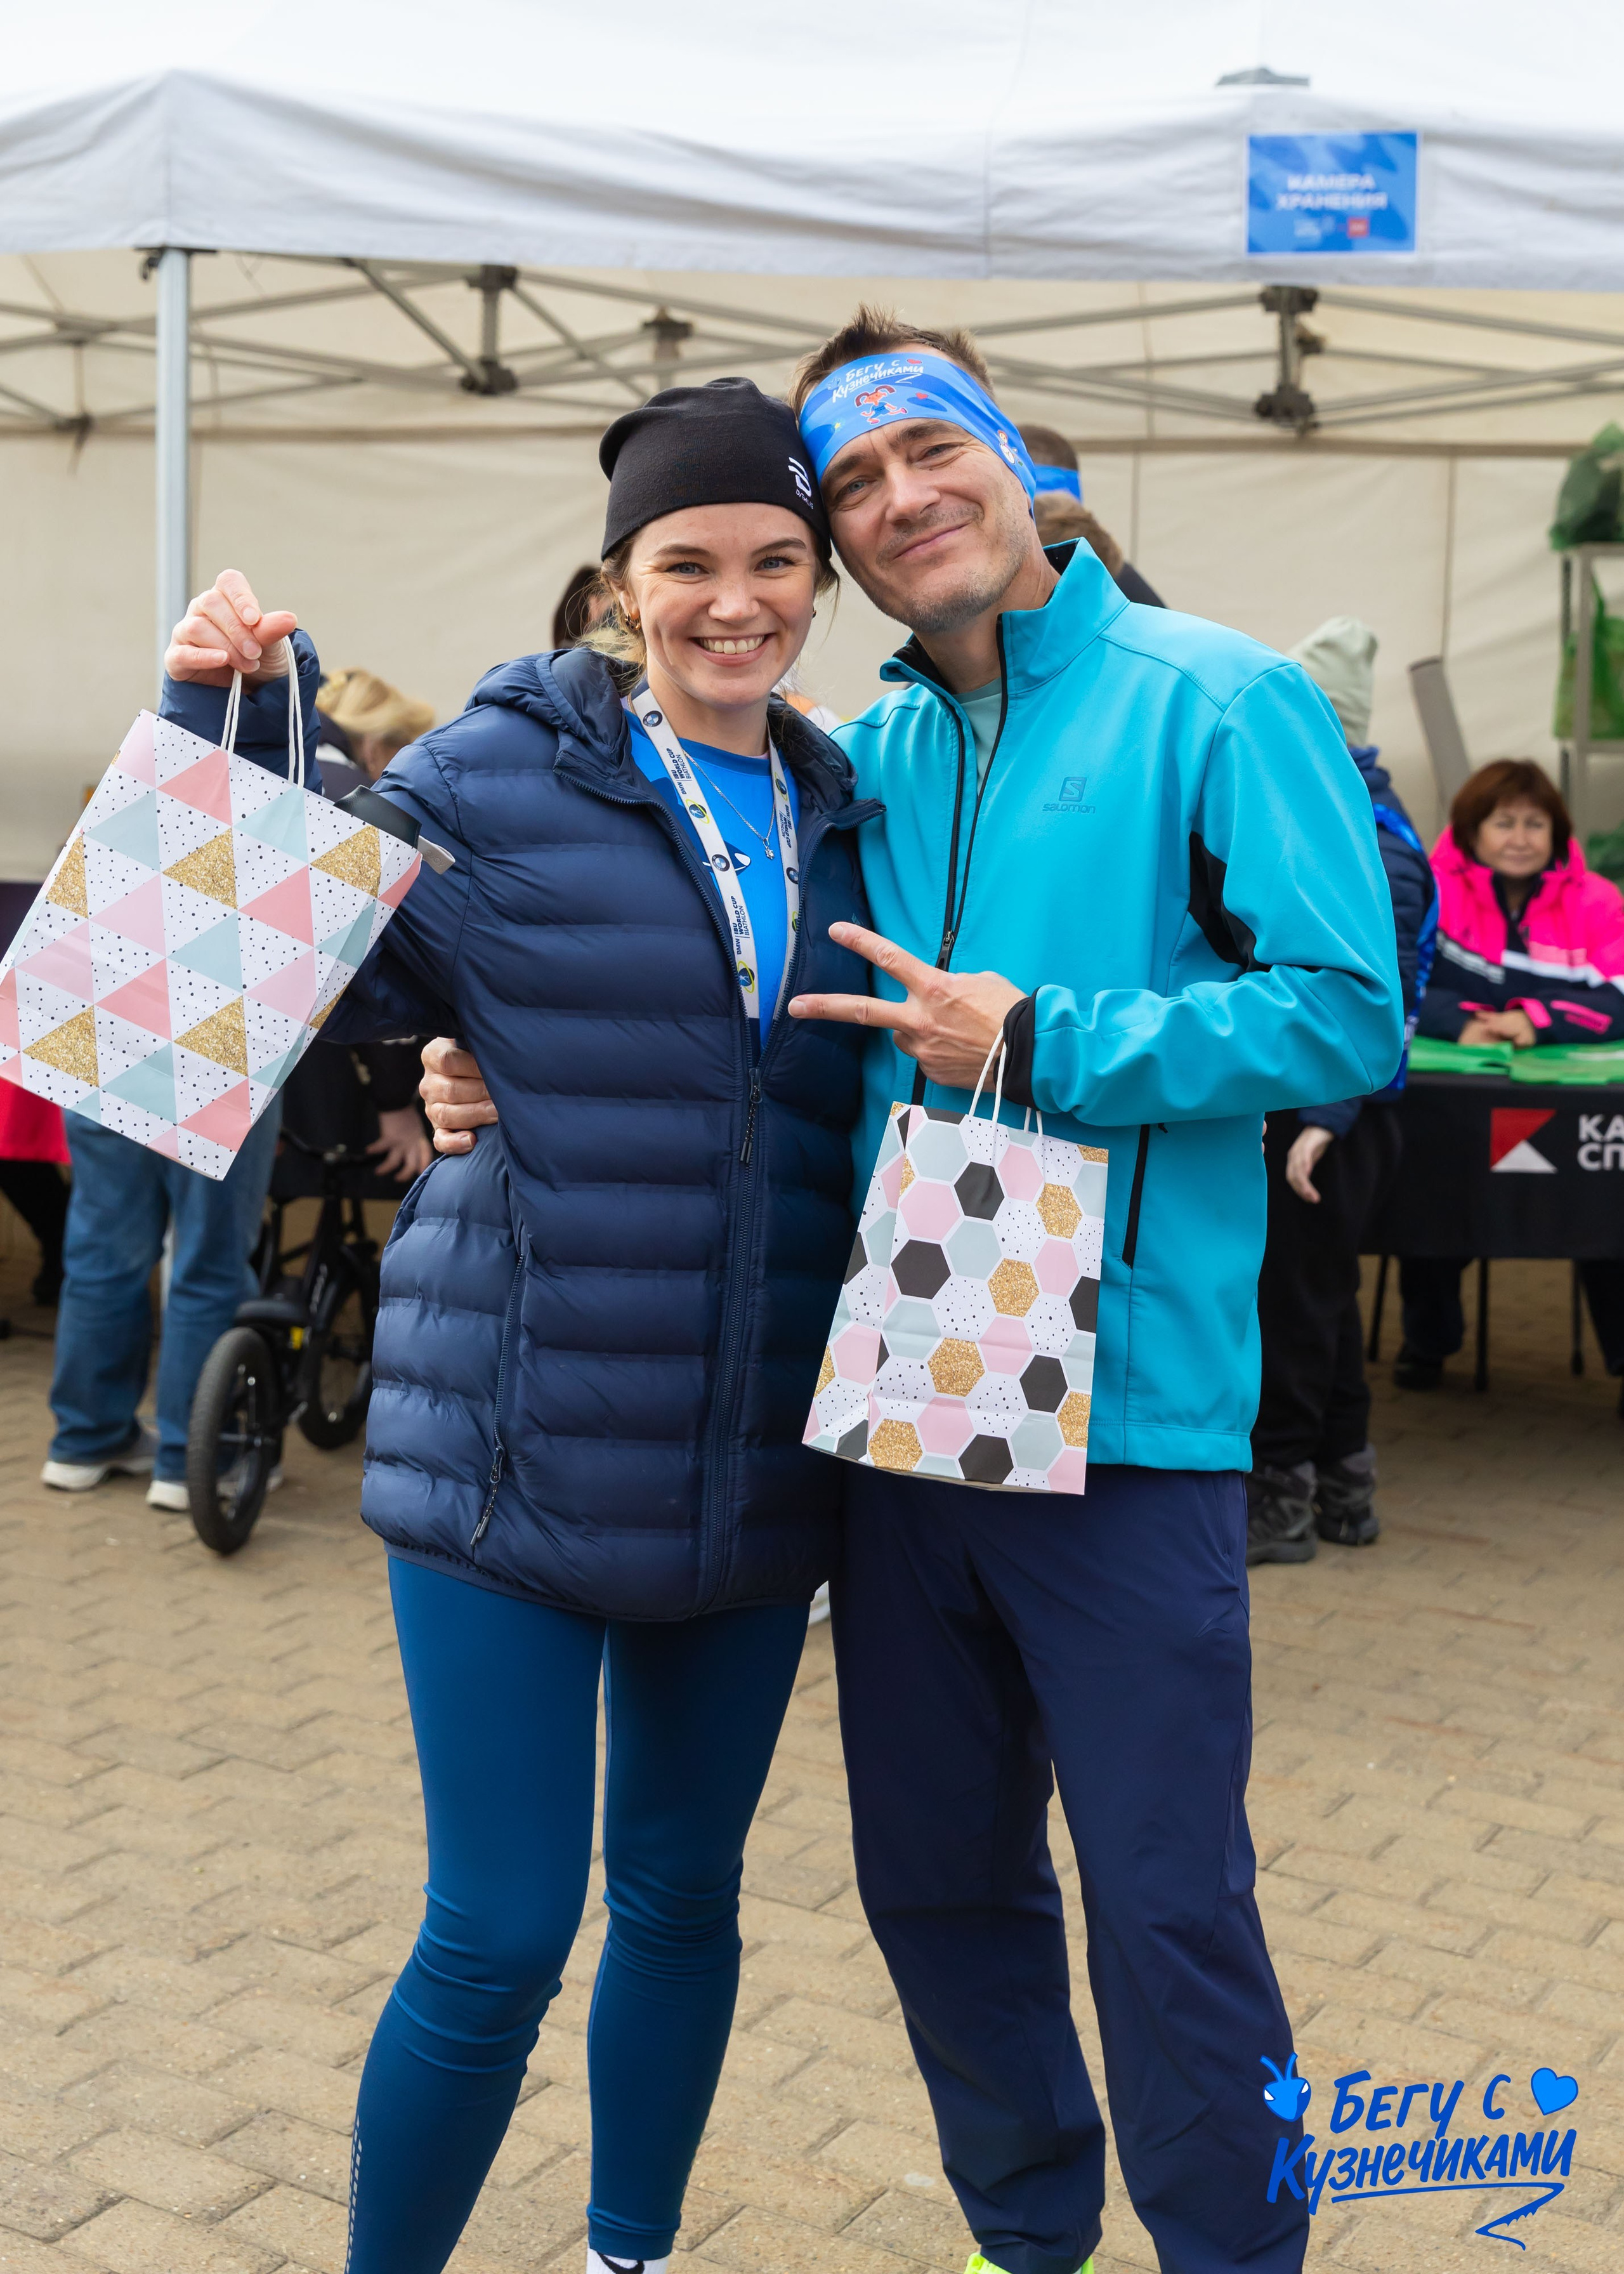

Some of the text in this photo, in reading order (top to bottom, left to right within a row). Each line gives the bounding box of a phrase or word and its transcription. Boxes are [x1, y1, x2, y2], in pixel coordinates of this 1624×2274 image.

[666, 748, 685, 779] WORLD CUP
[676, 754, 691, 779] BIATHLON
[671, 770, 687, 795] BMW IBU
[735, 910, 743, 935] WORLD
[738, 905, 750, 936] BIATHLON
